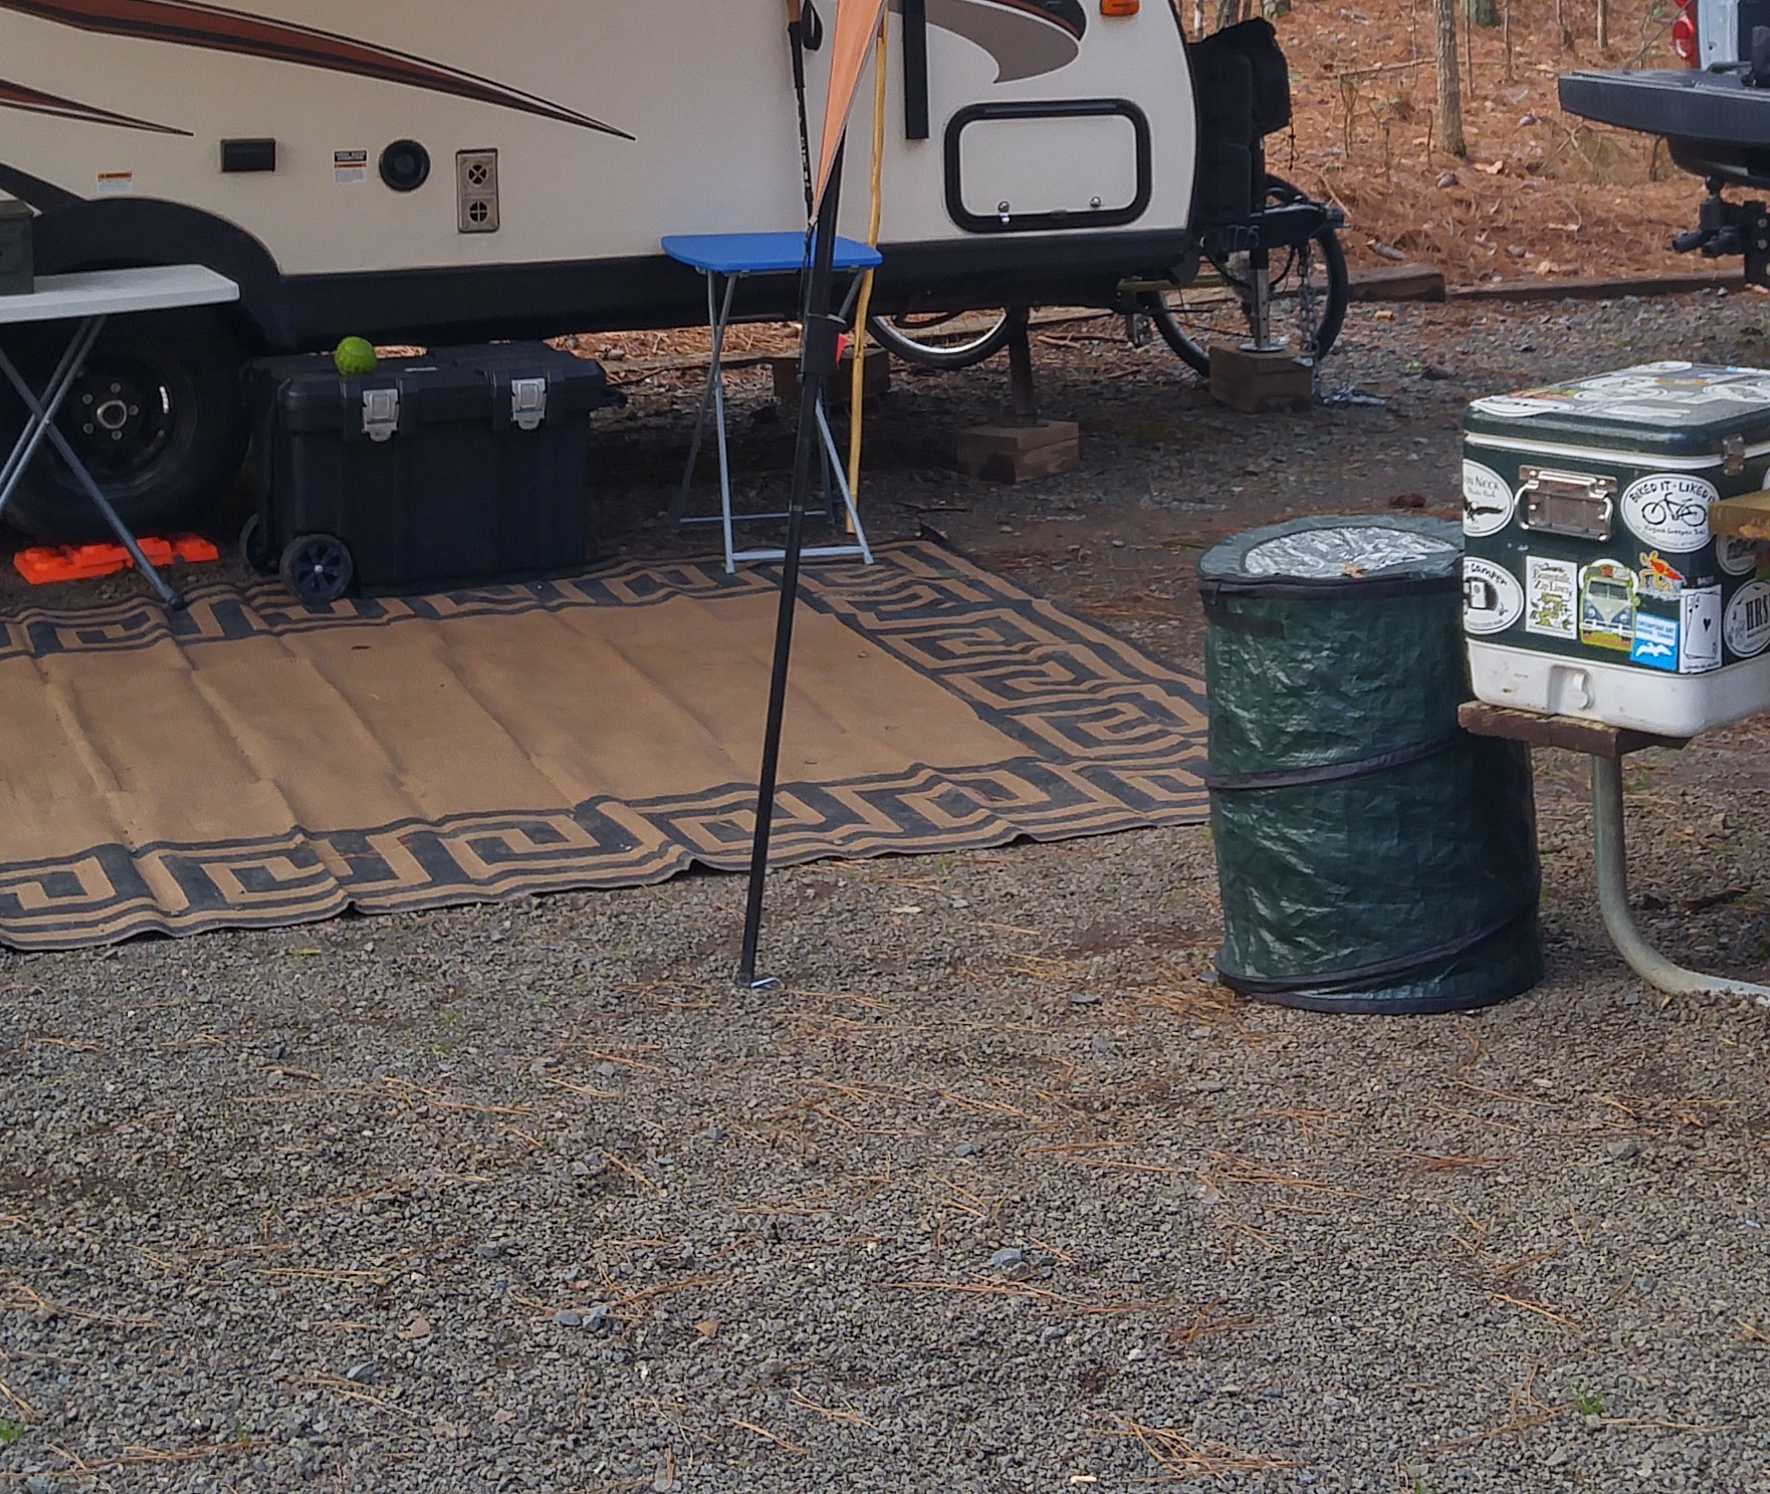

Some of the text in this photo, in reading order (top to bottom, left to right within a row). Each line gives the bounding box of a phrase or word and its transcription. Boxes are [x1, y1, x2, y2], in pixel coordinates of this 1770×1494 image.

[1629, 483, 1657, 503] BIKED
[1660, 481, 1671, 491] IT
[1679, 482, 1708, 498] LIKED
